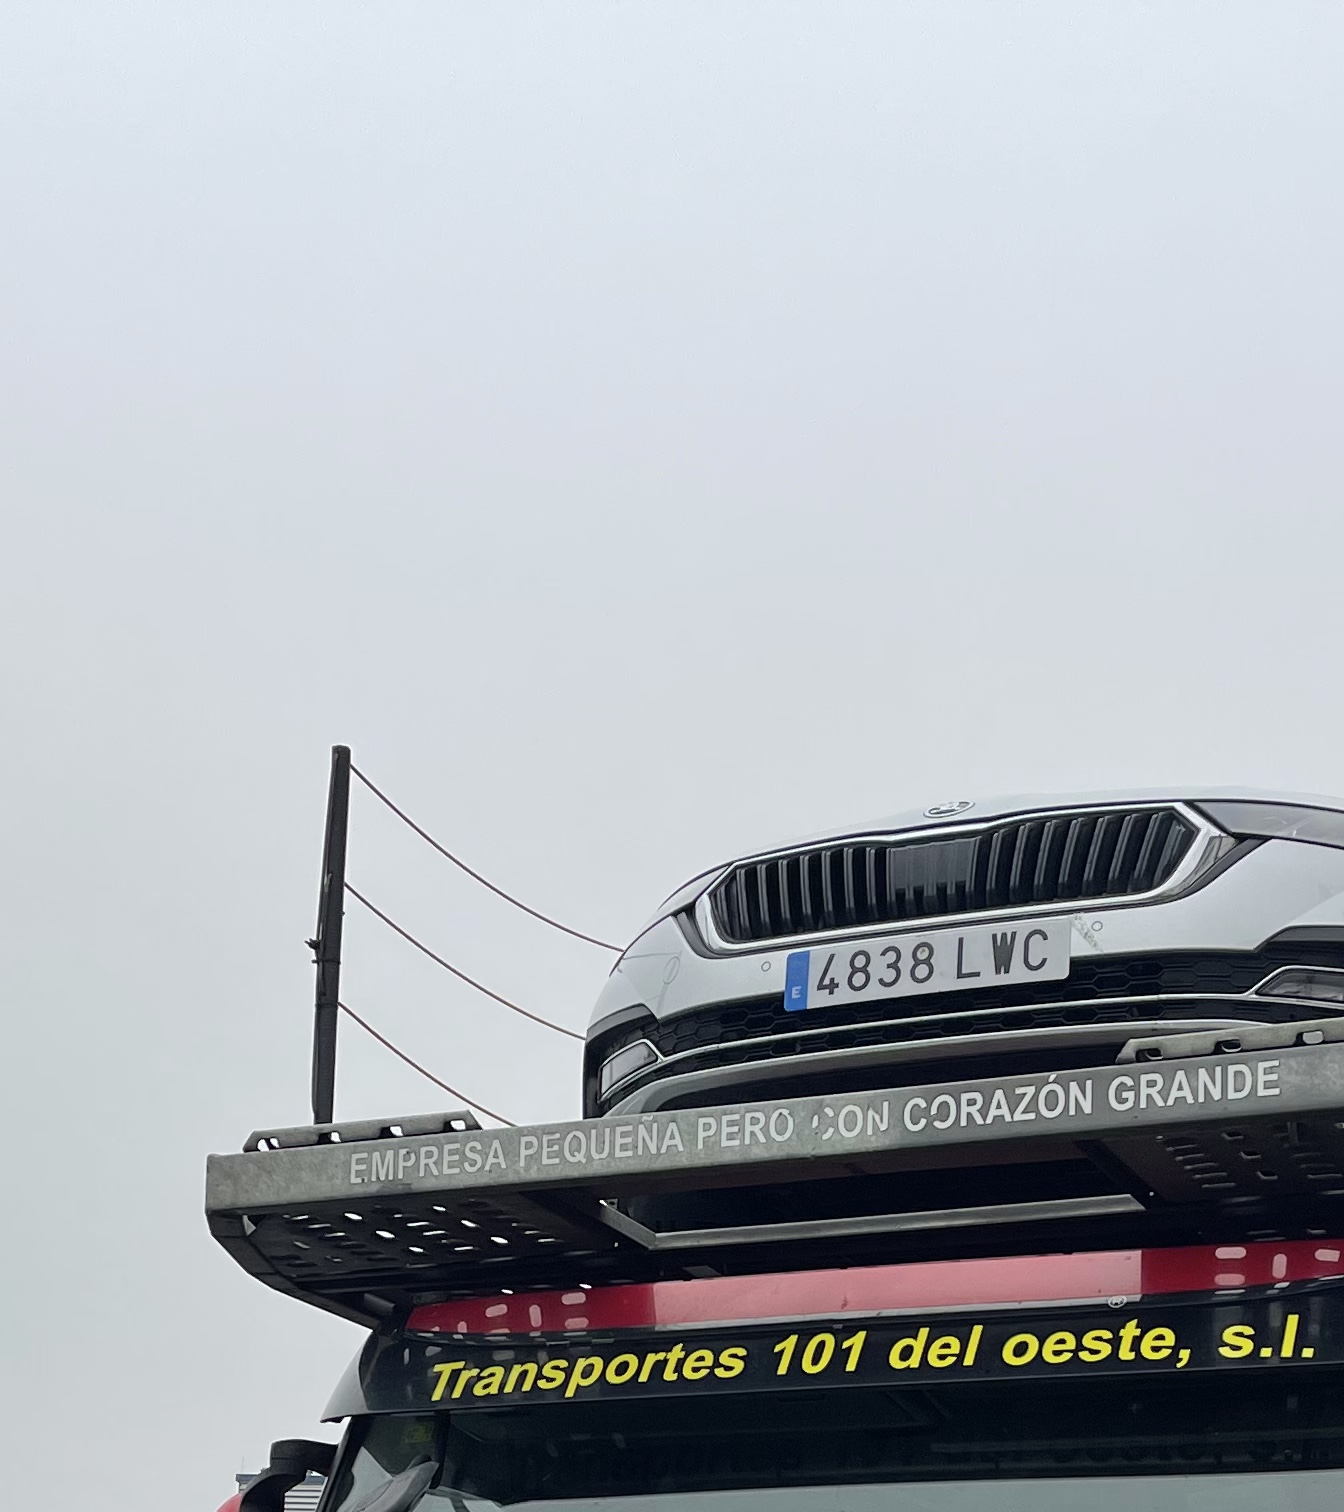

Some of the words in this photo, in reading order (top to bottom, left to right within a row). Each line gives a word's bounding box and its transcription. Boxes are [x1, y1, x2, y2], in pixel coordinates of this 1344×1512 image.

[816, 941, 935, 996] 4838
[956, 929, 1050, 980] LWC
[349, 1138, 507, 1184] EMPRESA
[518, 1114, 684, 1167] PEQUEÑA
[696, 1108, 795, 1150] PERO
[811, 1104, 890, 1142] CON
[902, 1074, 1093, 1132] CORAZÓN
[1107, 1059, 1282, 1112] GRANDE
[430, 1343, 748, 1402] Transportes
[772, 1333, 866, 1376] 101
[888, 1324, 984, 1370] del
[1001, 1318, 1192, 1369] oeste,
[1217, 1314, 1316, 1360] s.l.
